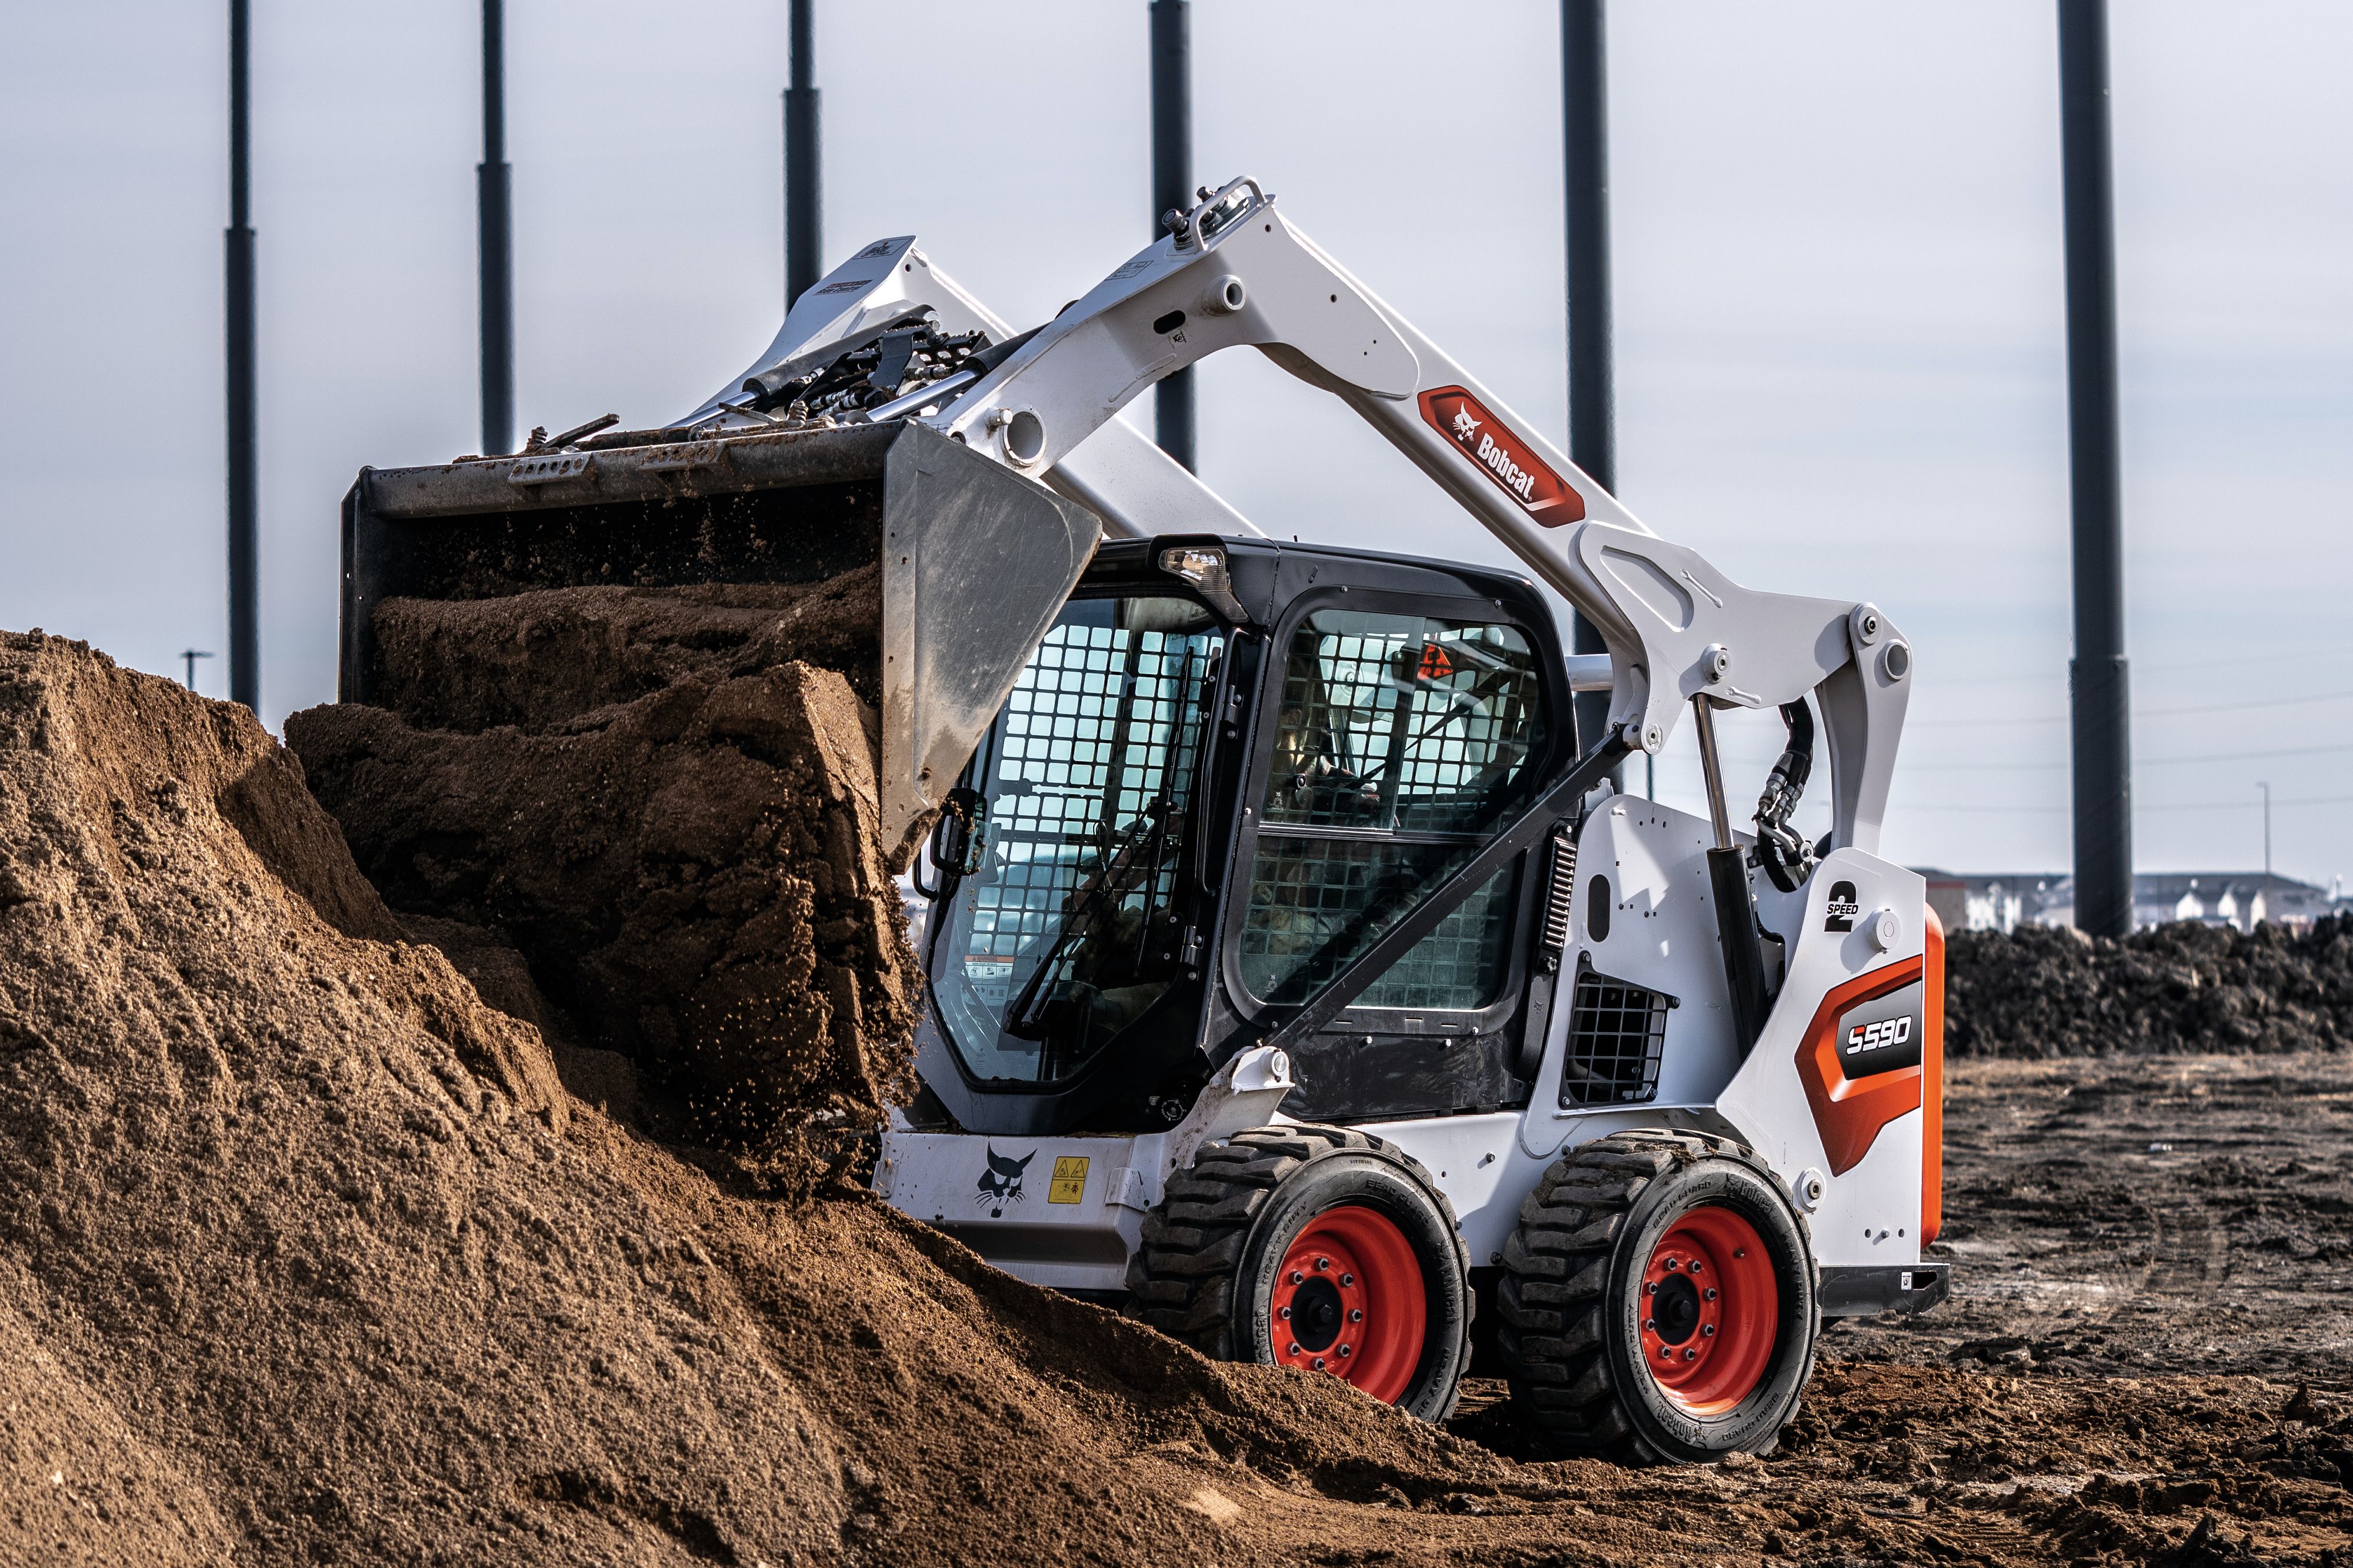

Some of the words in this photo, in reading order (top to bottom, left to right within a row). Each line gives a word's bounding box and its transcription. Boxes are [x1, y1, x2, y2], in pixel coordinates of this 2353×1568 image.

[1477, 433, 1534, 499] Bobcat
[1824, 880, 1857, 932] 2
[1827, 904, 1859, 915] SPEED
[1846, 1015, 1912, 1055] S590
[1632, 1349, 1649, 1394] HEAVY
